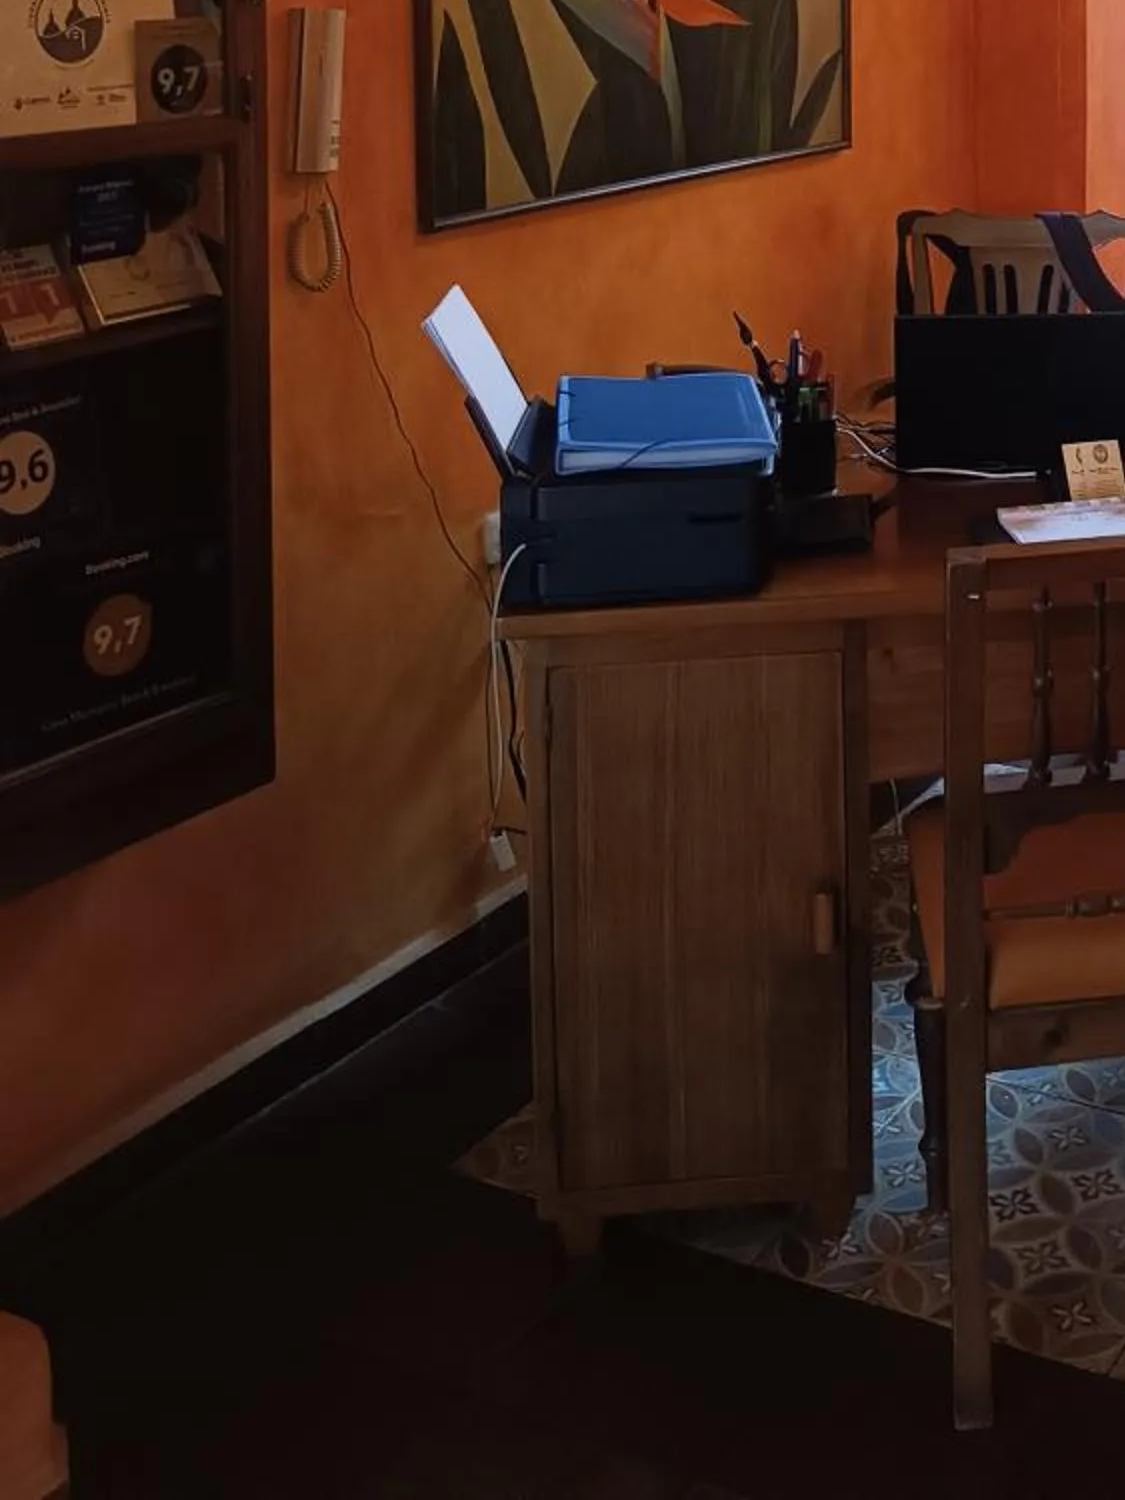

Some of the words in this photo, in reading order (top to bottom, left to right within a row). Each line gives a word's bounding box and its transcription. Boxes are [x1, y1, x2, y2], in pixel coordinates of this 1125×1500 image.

[157, 65, 200, 97] 9,7
[0, 449, 48, 494] 9,6
[93, 614, 143, 657] 9,7
